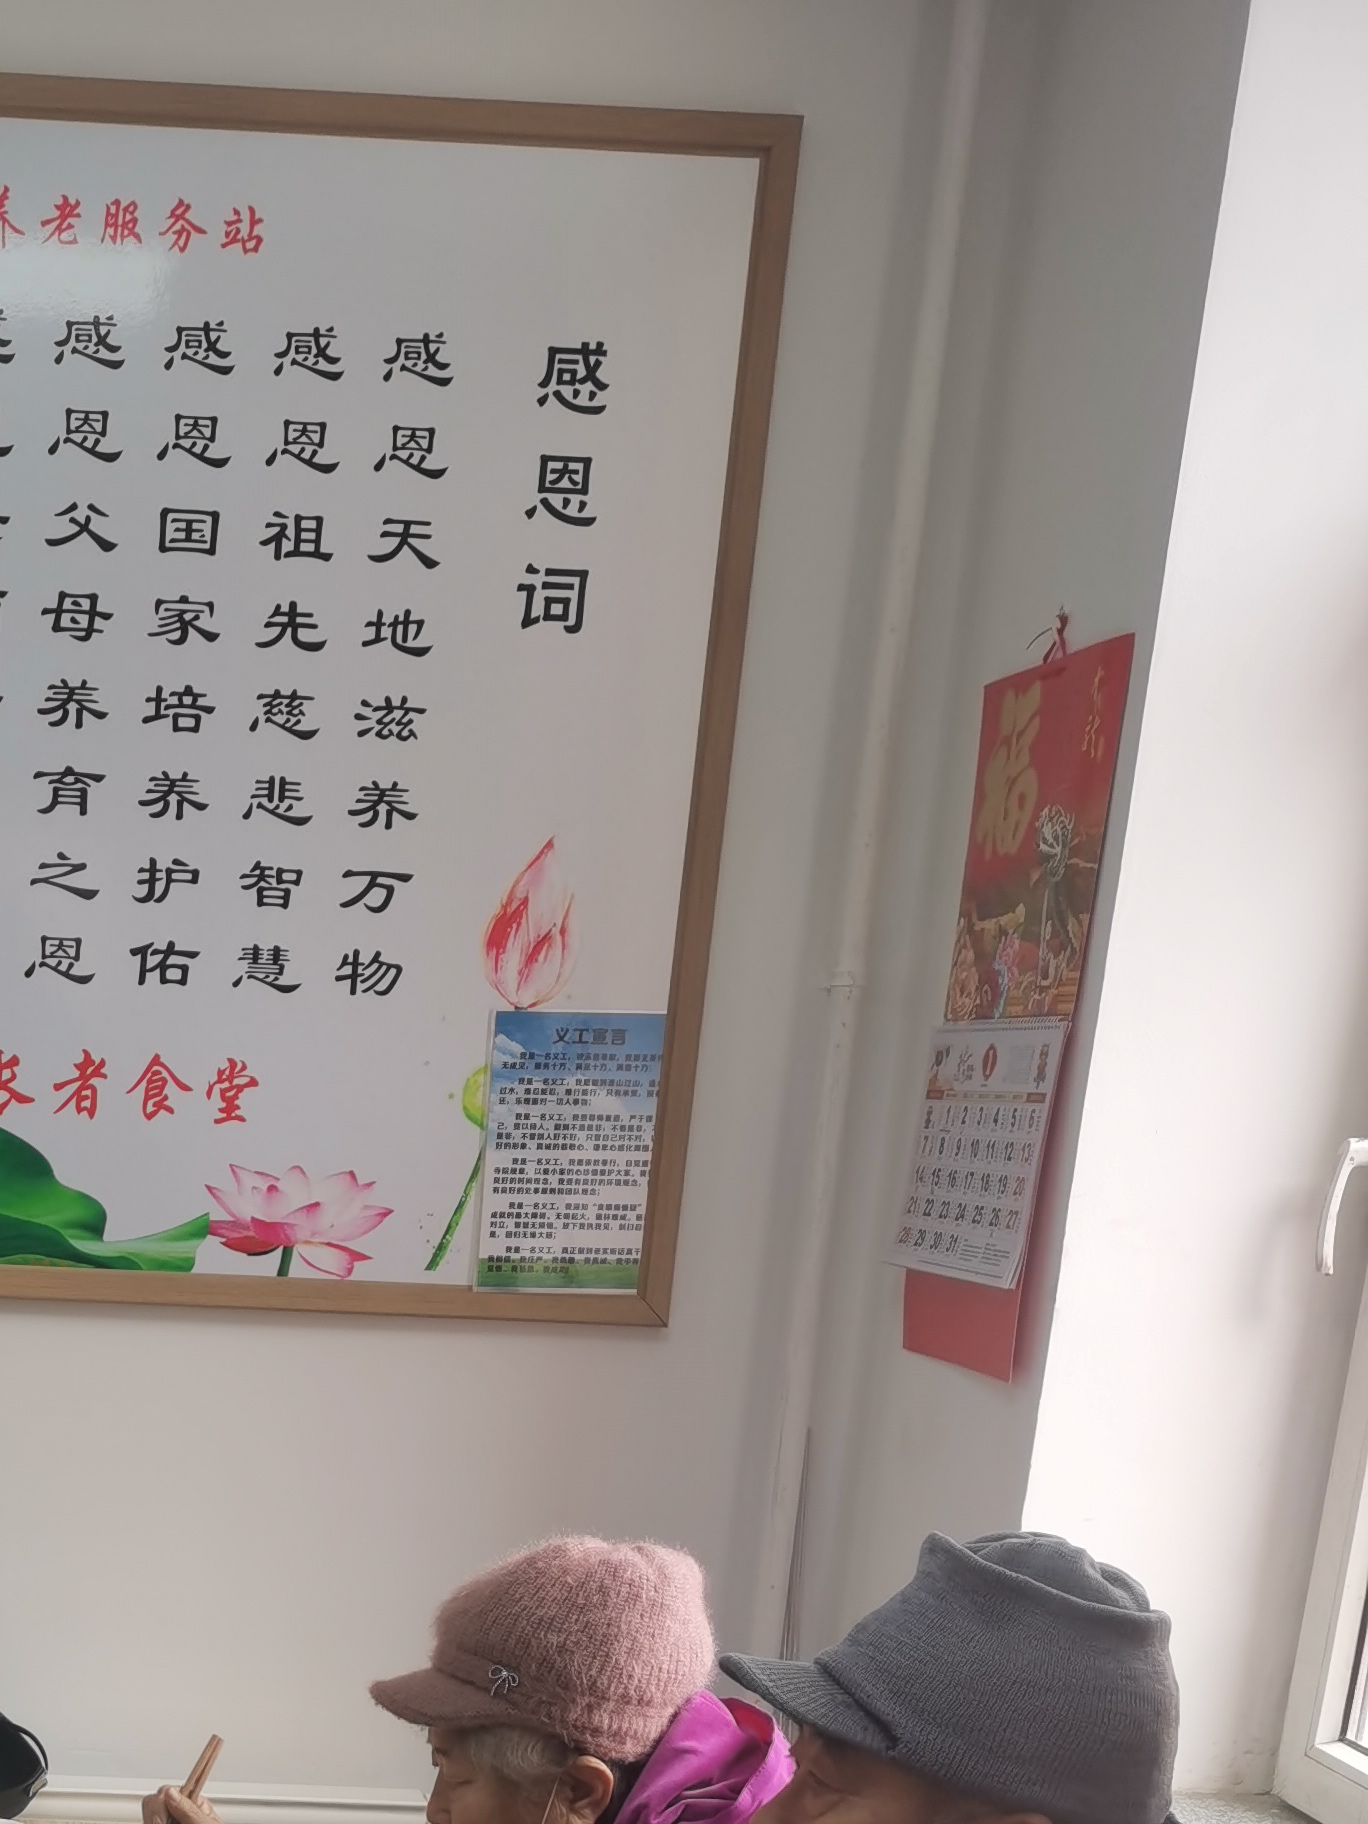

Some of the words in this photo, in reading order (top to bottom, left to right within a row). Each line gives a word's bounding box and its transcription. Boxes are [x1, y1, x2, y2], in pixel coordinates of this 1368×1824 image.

[517, 341, 609, 635] 感恩词
[24, 316, 125, 984] 感恩父母养育之恩
[130, 321, 235, 986] 感恩国家培养护佑
[232, 327, 344, 993] 感恩祖先慈悲智慧
[335, 332, 453, 996] 感恩天地滋养万物
[975, 679, 1041, 860] 福
[552, 1027, 628, 1046] 义工宣言
[922, 1135, 928, 1154] 7
[939, 1137, 945, 1155] 8
[955, 1138, 961, 1156] 9
[970, 1138, 979, 1158] 10
[986, 1139, 996, 1159] 11
[1004, 1141, 1014, 1162] 12
[1021, 1142, 1032, 1163] 13
[946, 1105, 951, 1125] 1
[961, 1106, 968, 1125] 2
[977, 1107, 983, 1126] 3
[993, 1107, 1000, 1126] 4
[1011, 1108, 1017, 1127] 5
[1029, 1109, 1035, 1128] 6
[907, 1196, 918, 1215] 21
[923, 1198, 934, 1216] 22
[939, 1201, 950, 1219] 23
[955, 1202, 967, 1222] 24
[972, 1205, 984, 1224] 25
[989, 1207, 1001, 1227] 26
[1006, 1210, 1019, 1230] 27
[915, 1165, 925, 1183] 14
[931, 1168, 941, 1187] 15
[947, 1169, 957, 1188] 16
[964, 1171, 974, 1190] 17
[980, 1172, 990, 1192] 18
[998, 1174, 1007, 1194] 19
[1013, 1176, 1025, 1196] 20
[898, 1226, 911, 1244] 28
[914, 1229, 926, 1247] 29
[930, 1231, 942, 1250] 30
[946, 1234, 959, 1253] 31
